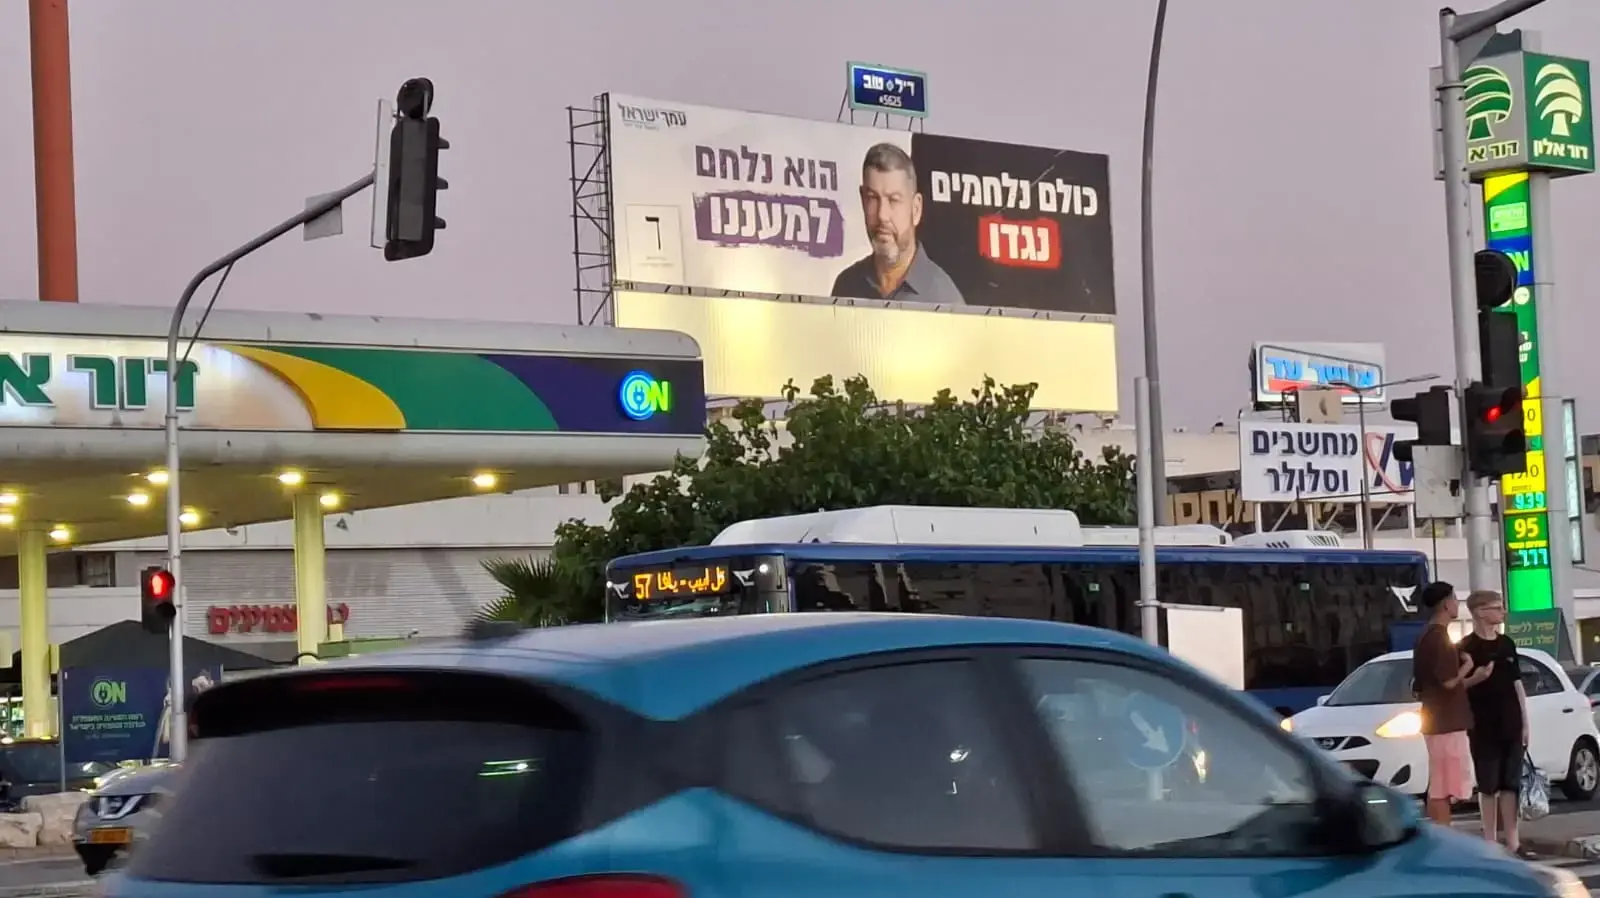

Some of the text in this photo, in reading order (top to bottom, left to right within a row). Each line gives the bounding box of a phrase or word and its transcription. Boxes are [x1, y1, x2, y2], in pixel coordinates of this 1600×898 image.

[862, 74, 884, 91] טוב
[616, 101, 687, 127] עמך ישראל
[1488, 139, 1520, 160] דור
[1532, 137, 1589, 160] דור אלון
[695, 145, 838, 192] הוא נלחם
[930, 170, 1098, 217] כולם נלחמים
[710, 196, 832, 244] למעננו
[988, 220, 1050, 262] נגדו
[1265, 356, 1304, 381] עד
[67, 354, 200, 411] דור
[624, 376, 669, 414] ON
[1251, 430, 1358, 456] מחשבים
[1266, 461, 1350, 493] וסלולר
[1514, 517, 1539, 538] 95
[634, 574, 652, 599] 57
[92, 680, 127, 705] ON
